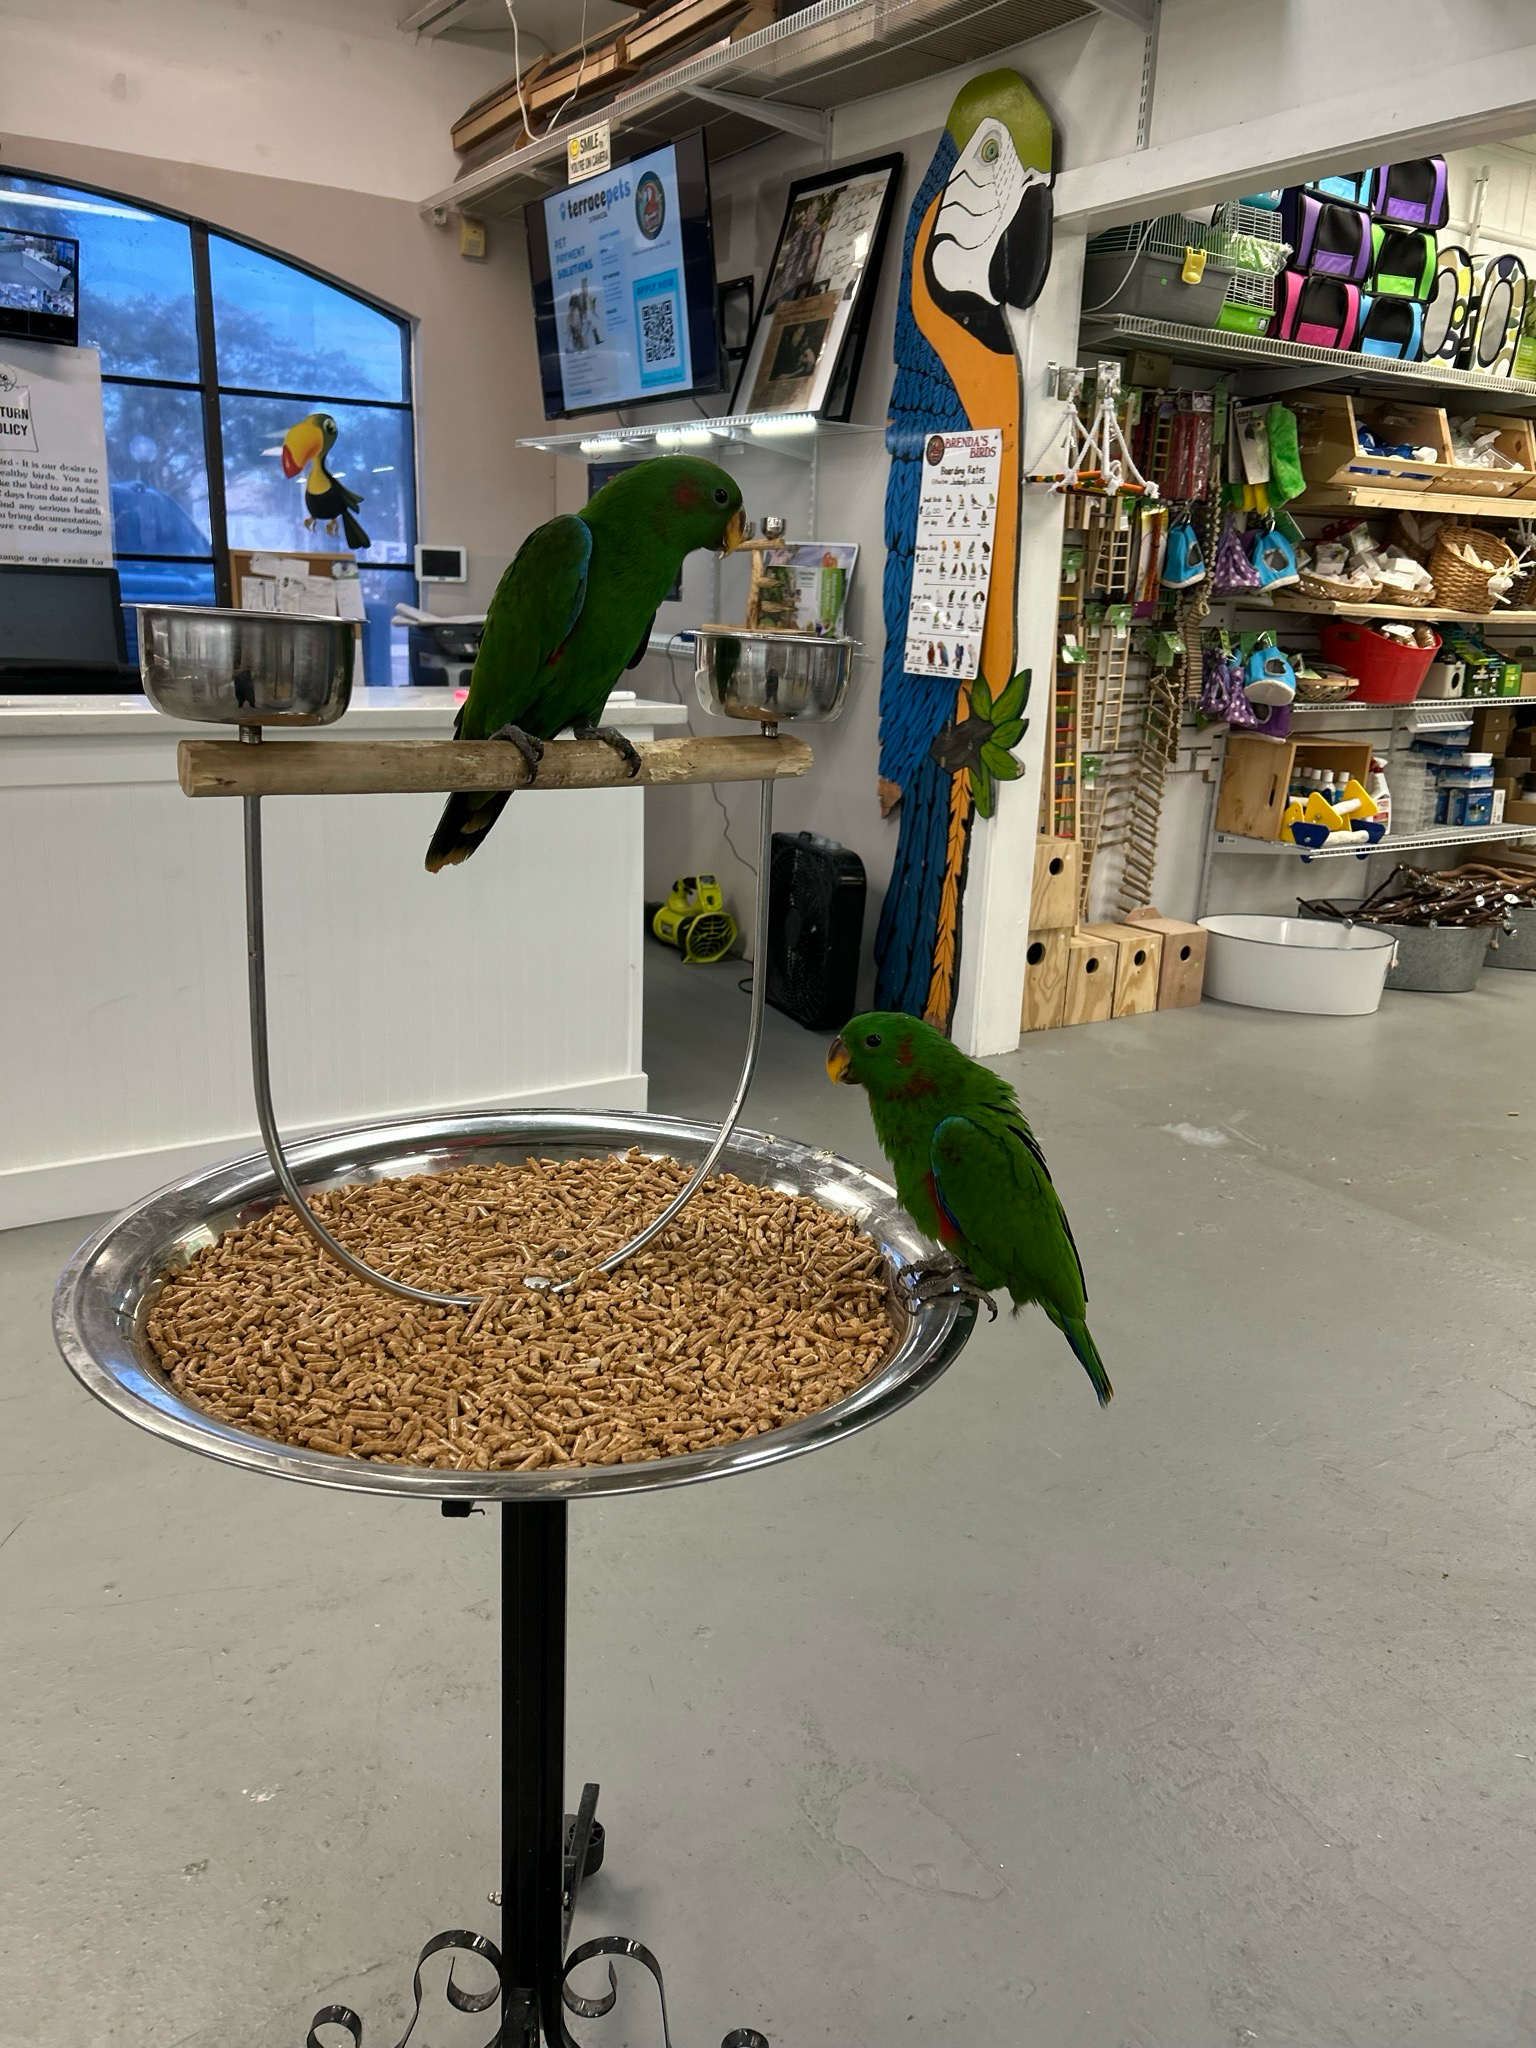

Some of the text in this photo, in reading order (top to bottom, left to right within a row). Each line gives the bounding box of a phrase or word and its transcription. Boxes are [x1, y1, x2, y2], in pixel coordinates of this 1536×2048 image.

[580, 132, 599, 154] SMILE
[568, 179, 631, 219] terracepets
[554, 237, 566, 250] PET
[557, 259, 593, 280] SOLUTIONS
[0, 406, 29, 420] TURN
[944, 435, 989, 449] BRENDA'S
[970, 446, 997, 459] BIRDS
[60, 463, 86, 472] desire
[941, 465, 986, 478] Boarding Rates
[33, 471, 58, 481] birds.
[63, 474, 80, 482] You
[13, 480, 27, 488] the
[30, 482, 48, 490] bird
[75, 486, 99, 495] Avian
[4, 490, 25, 499] days
[27, 492, 47, 500] from
[50, 494, 69, 502] date
[39, 505, 71, 513] serious
[74, 507, 101, 515] health
[8, 511, 32, 521] bring
[34, 513, 102, 526] documentation,
[19, 523, 44, 531] credit
[62, 526, 103, 537] exchange
[42, 556, 60, 564] give
[63, 557, 88, 565] credit
